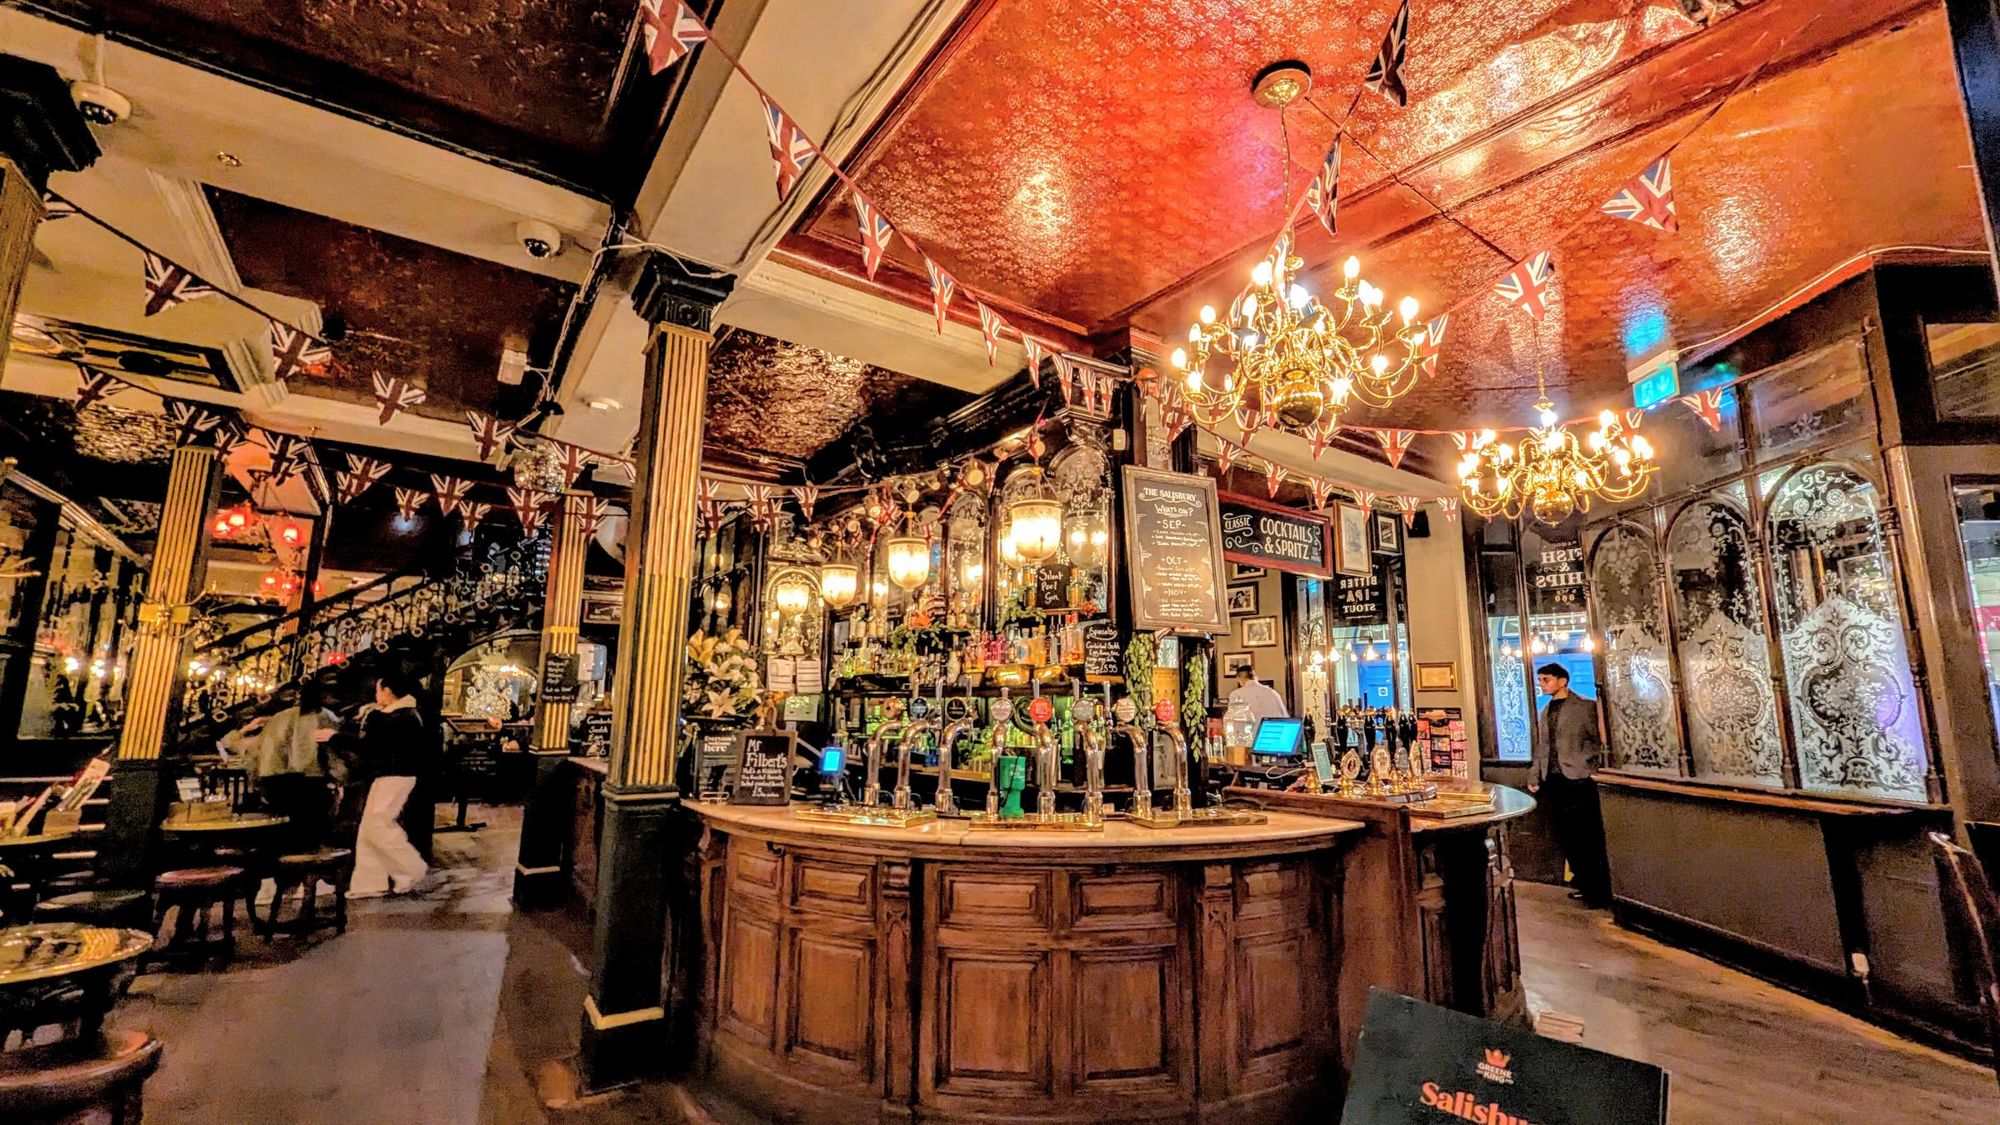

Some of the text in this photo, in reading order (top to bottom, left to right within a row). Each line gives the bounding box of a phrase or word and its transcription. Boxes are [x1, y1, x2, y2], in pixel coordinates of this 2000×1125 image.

[1143, 487, 1197, 502] THE SALISBURY
[1225, 517, 1252, 530] CLASSIC
[1260, 517, 1313, 543] COCKTAILS
[1264, 537, 1274, 554] &
[1275, 538, 1310, 560] SPRITZ
[704, 744, 727, 752] here
[747, 739, 762, 752] Mr
[744, 752, 788, 768] Filbert's
[1478, 1062, 1512, 1079] GREENE
[1483, 1070, 1505, 1084] KING
